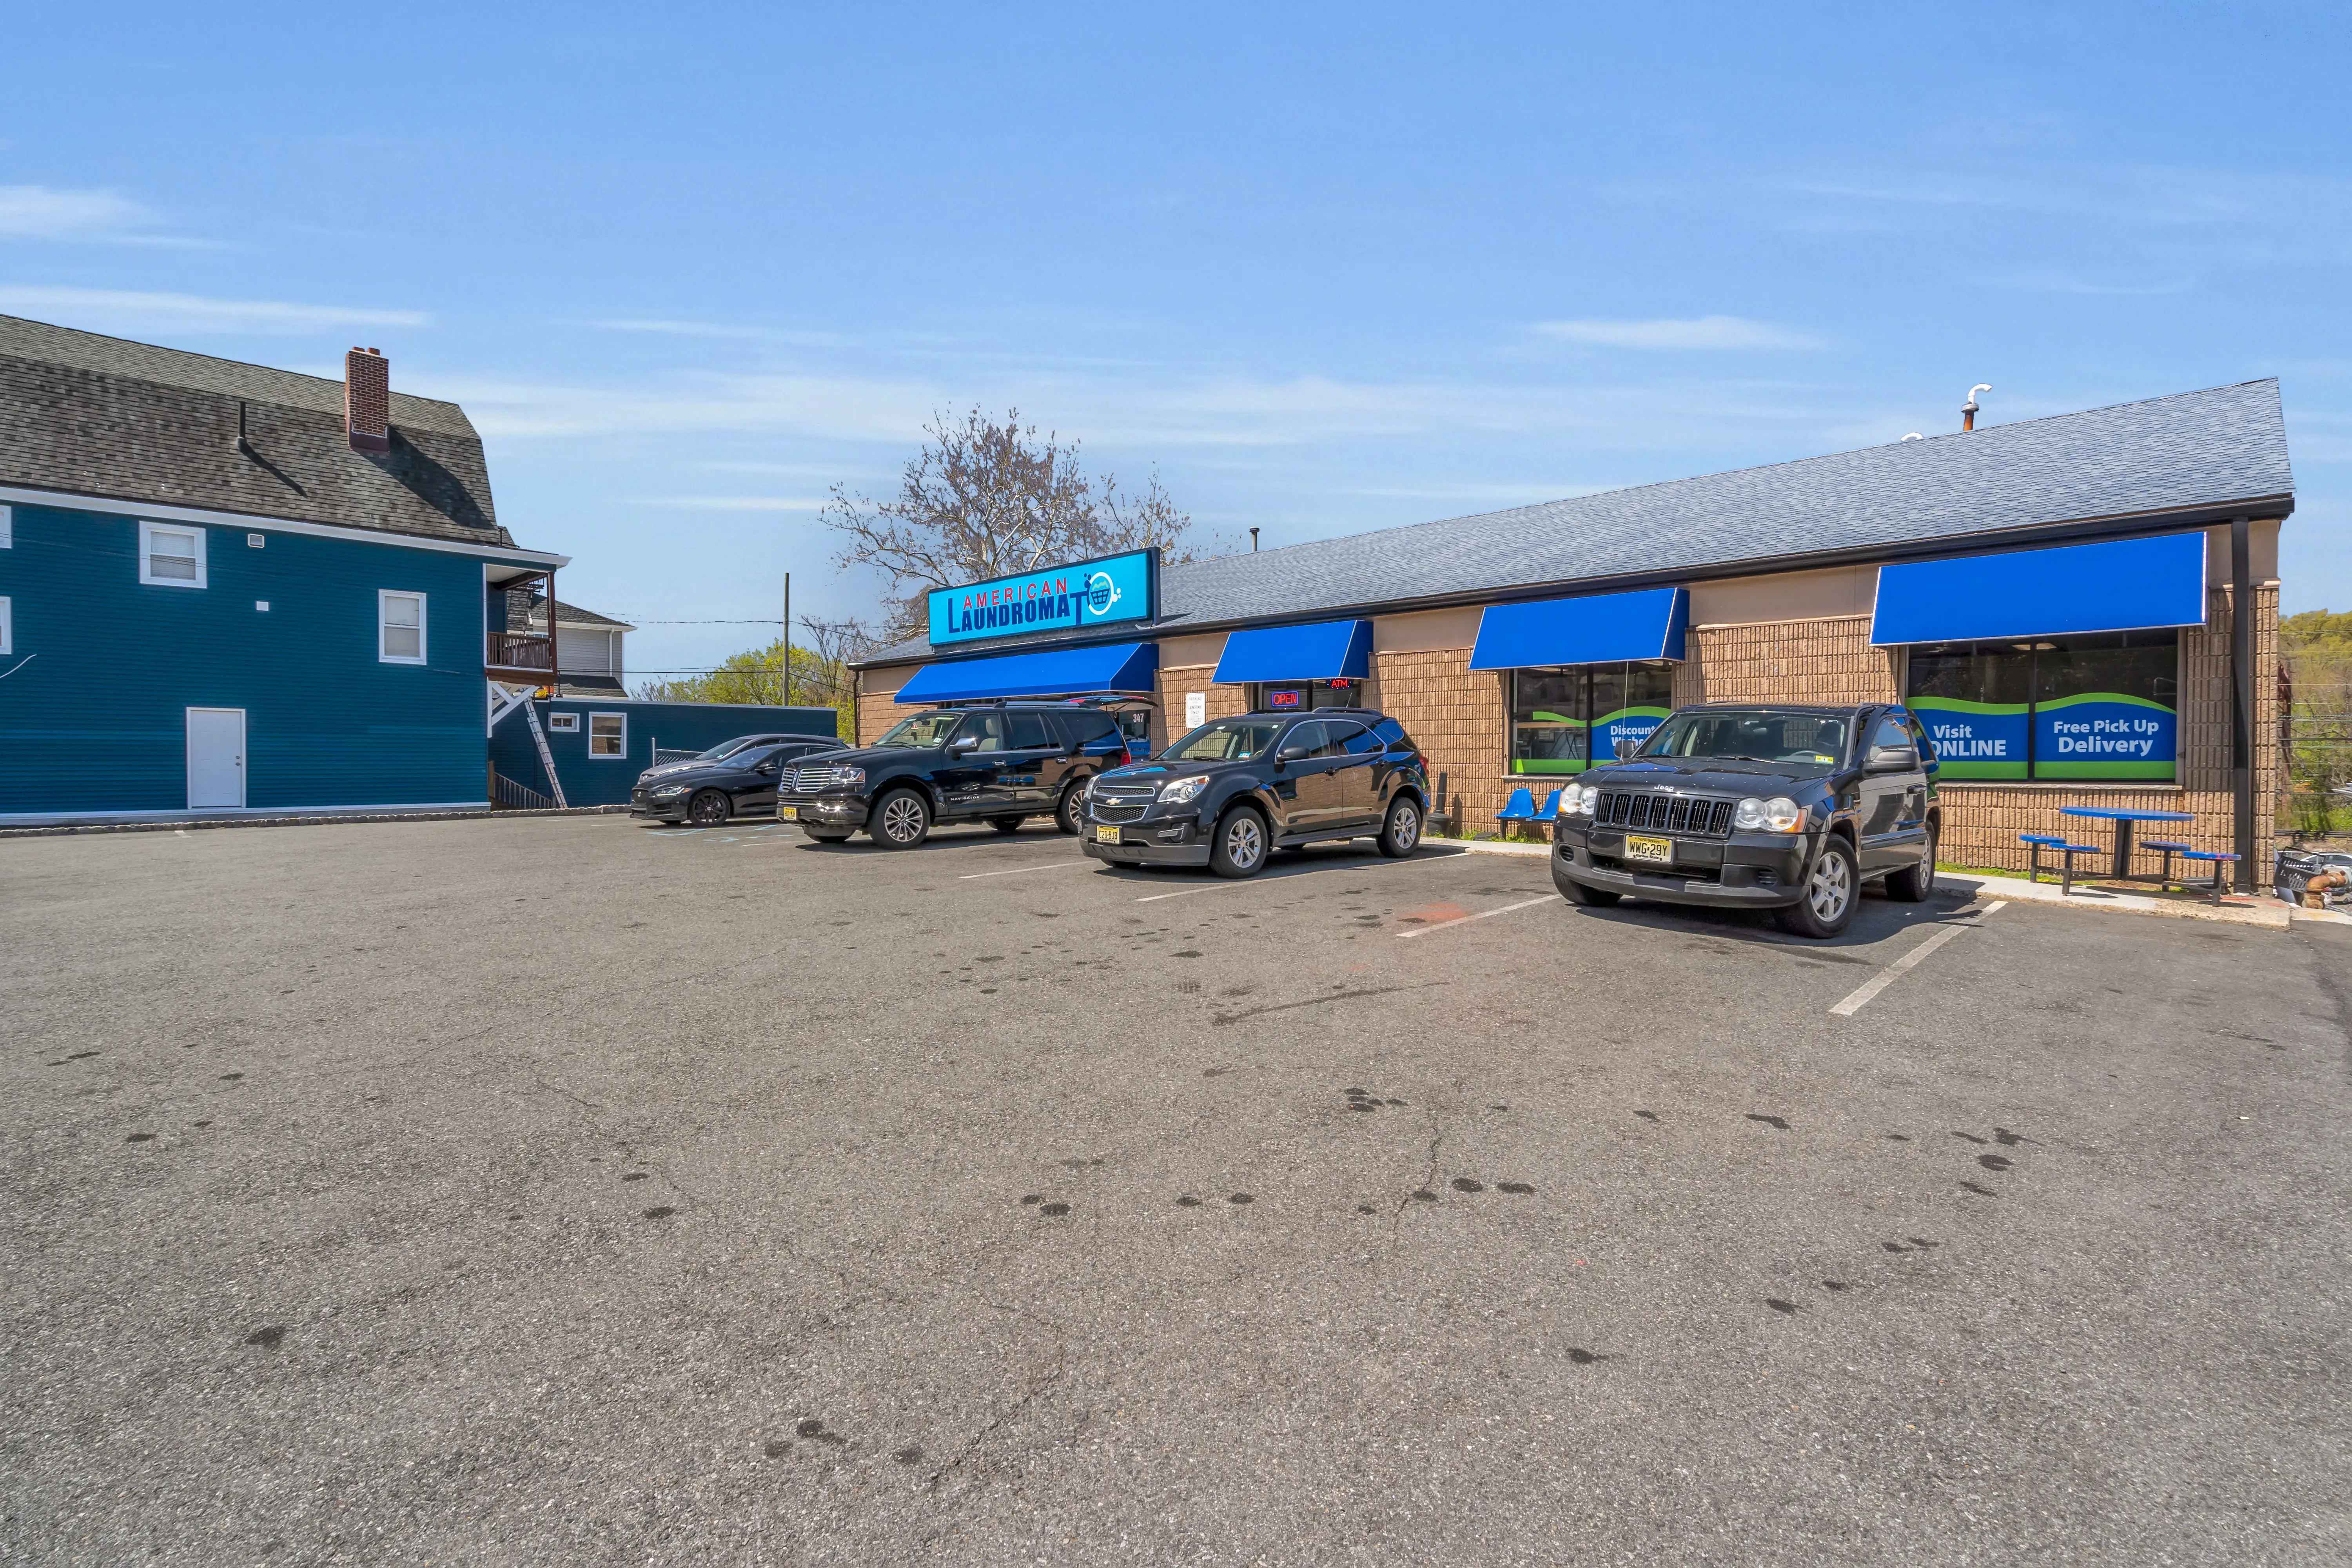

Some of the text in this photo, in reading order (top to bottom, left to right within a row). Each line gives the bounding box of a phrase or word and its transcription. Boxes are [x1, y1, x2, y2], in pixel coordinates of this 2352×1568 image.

[963, 577, 1068, 610] AMERICAN
[948, 591, 1089, 633] LAUNDROMAT
[1273, 693, 1297, 705] OPEN
[1133, 713, 1144, 722] 347
[1933, 724, 1972, 738] Visit
[2054, 719, 2159, 735] Free Pick Up
[1931, 740, 2006, 756] ONLINE
[2058, 736, 2153, 757] Delivery
